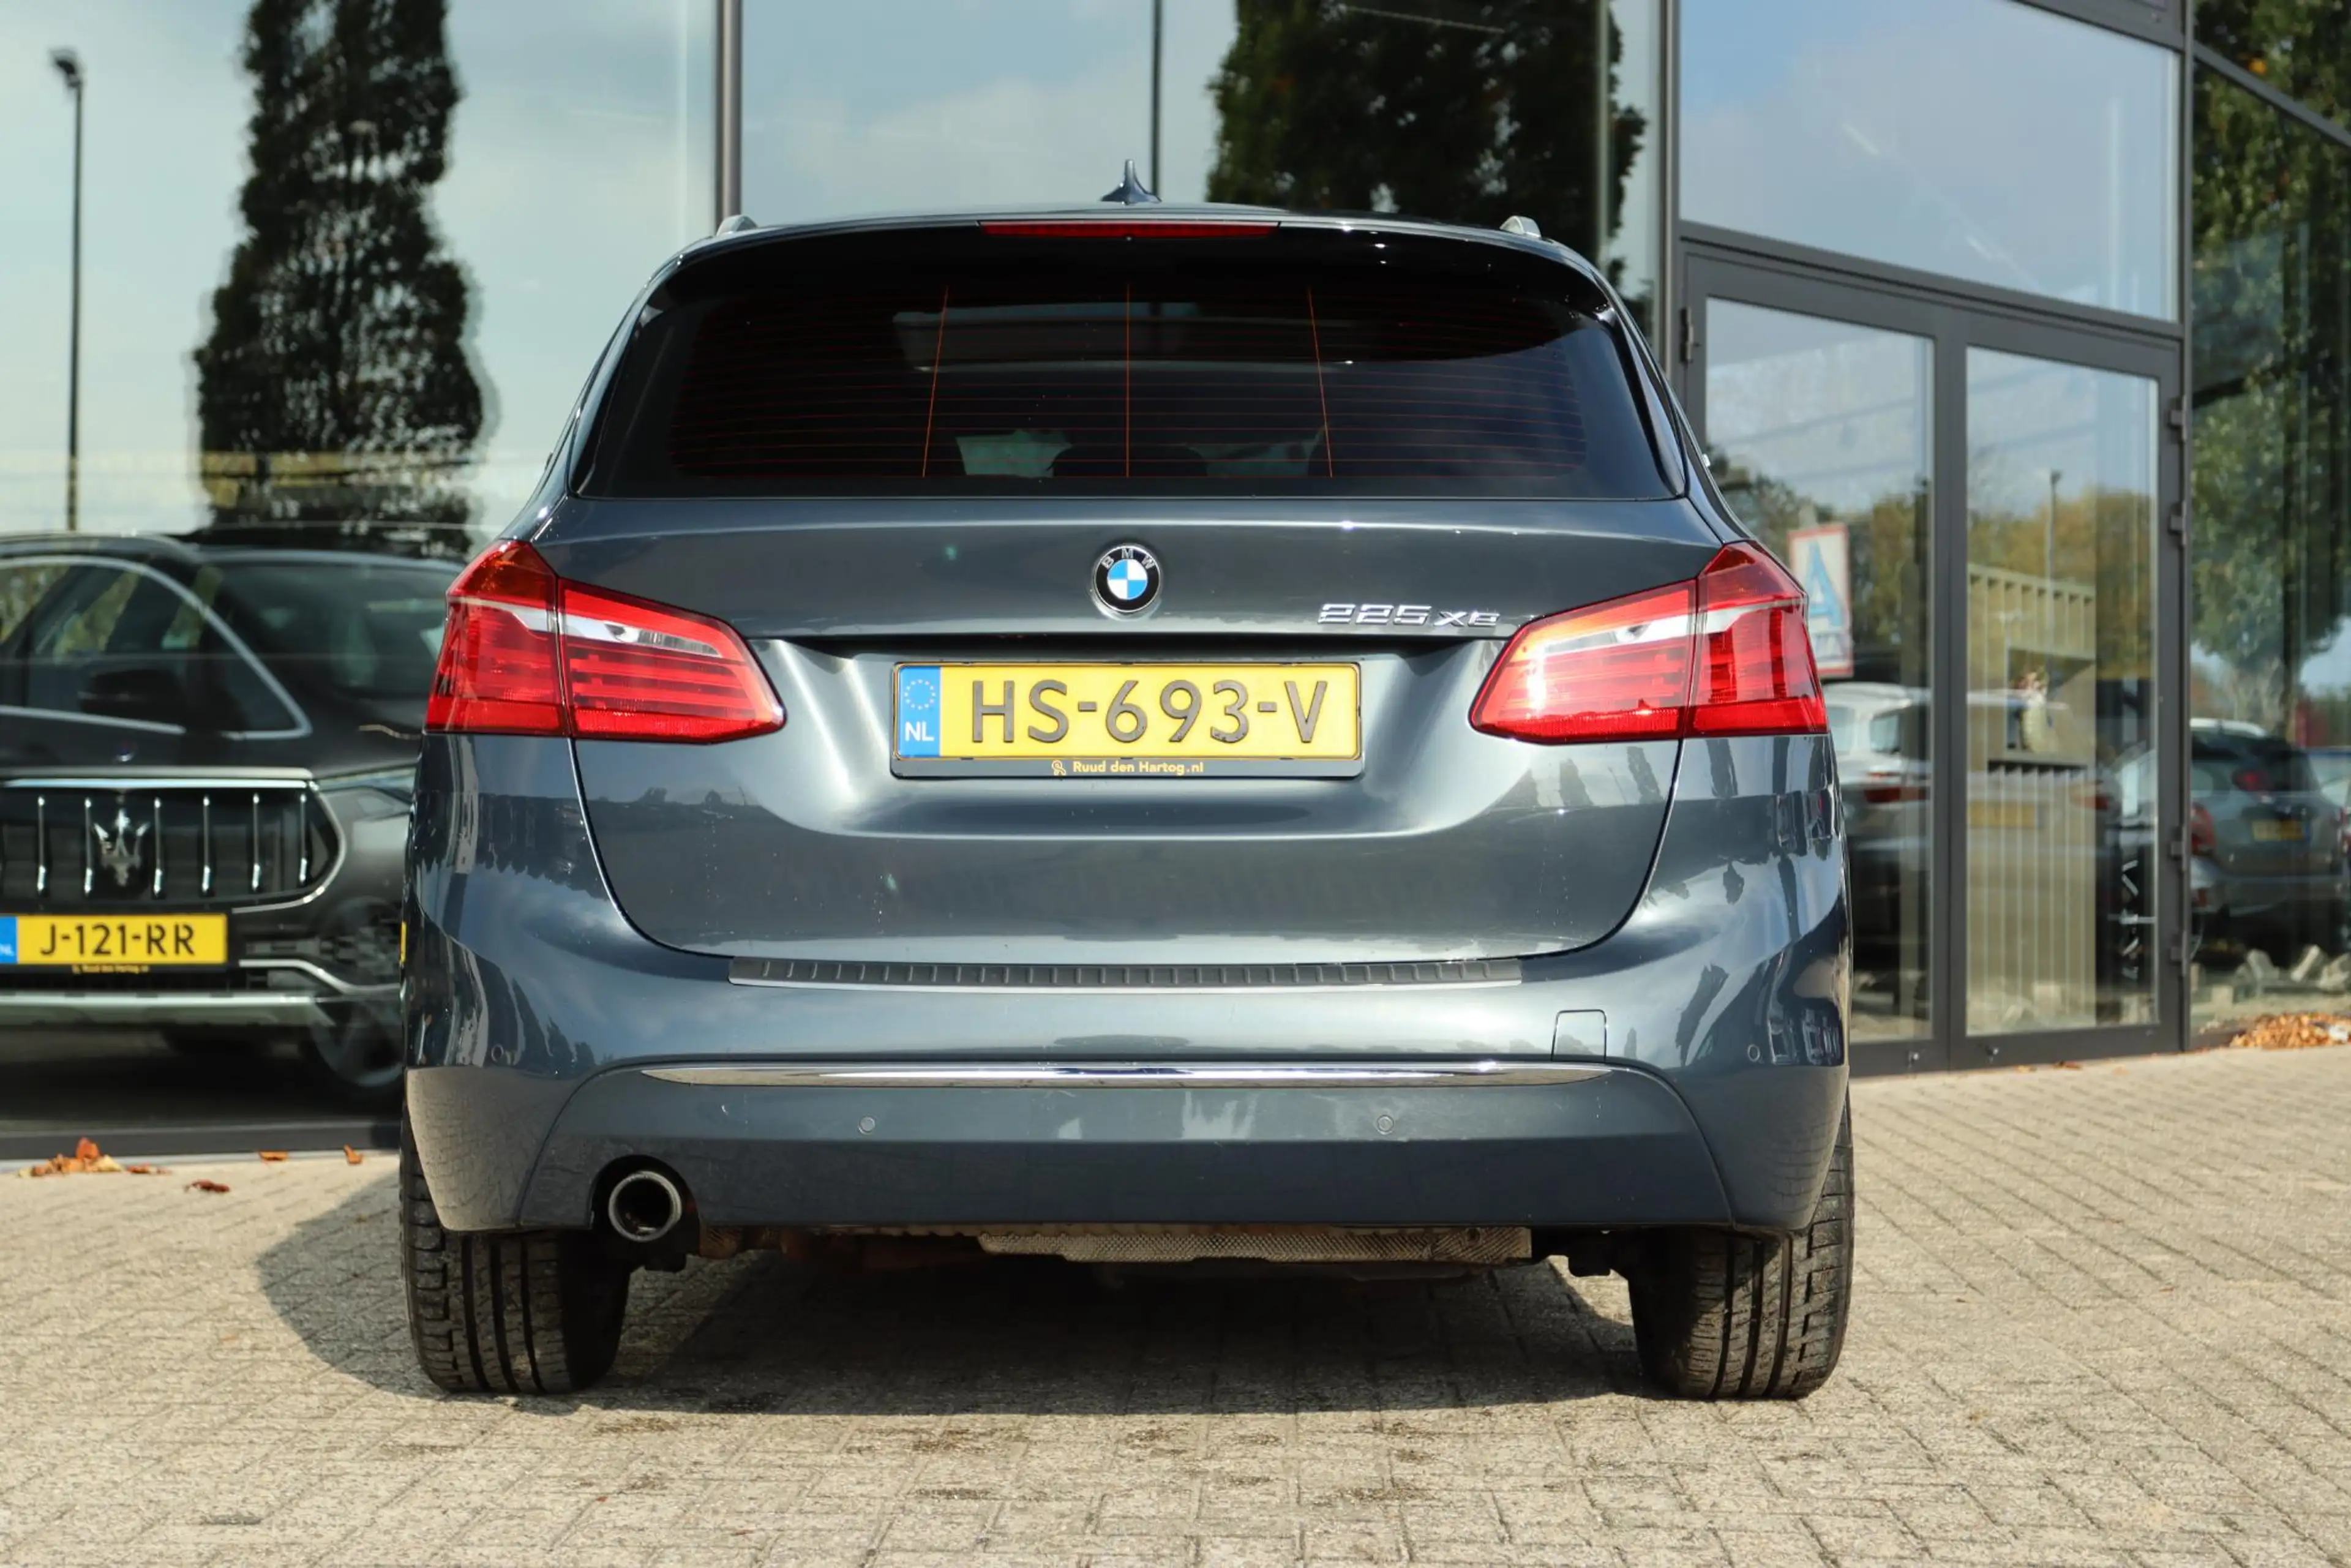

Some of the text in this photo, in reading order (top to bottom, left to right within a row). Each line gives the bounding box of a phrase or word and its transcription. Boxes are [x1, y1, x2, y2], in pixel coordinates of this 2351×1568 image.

[1101, 547, 1155, 569] BMW
[972, 679, 1328, 743] HS-693-V
[904, 721, 935, 741] NL
[1073, 761, 1204, 775] Ruud den Hartog.nl
[40, 924, 195, 956] J-121-RR
